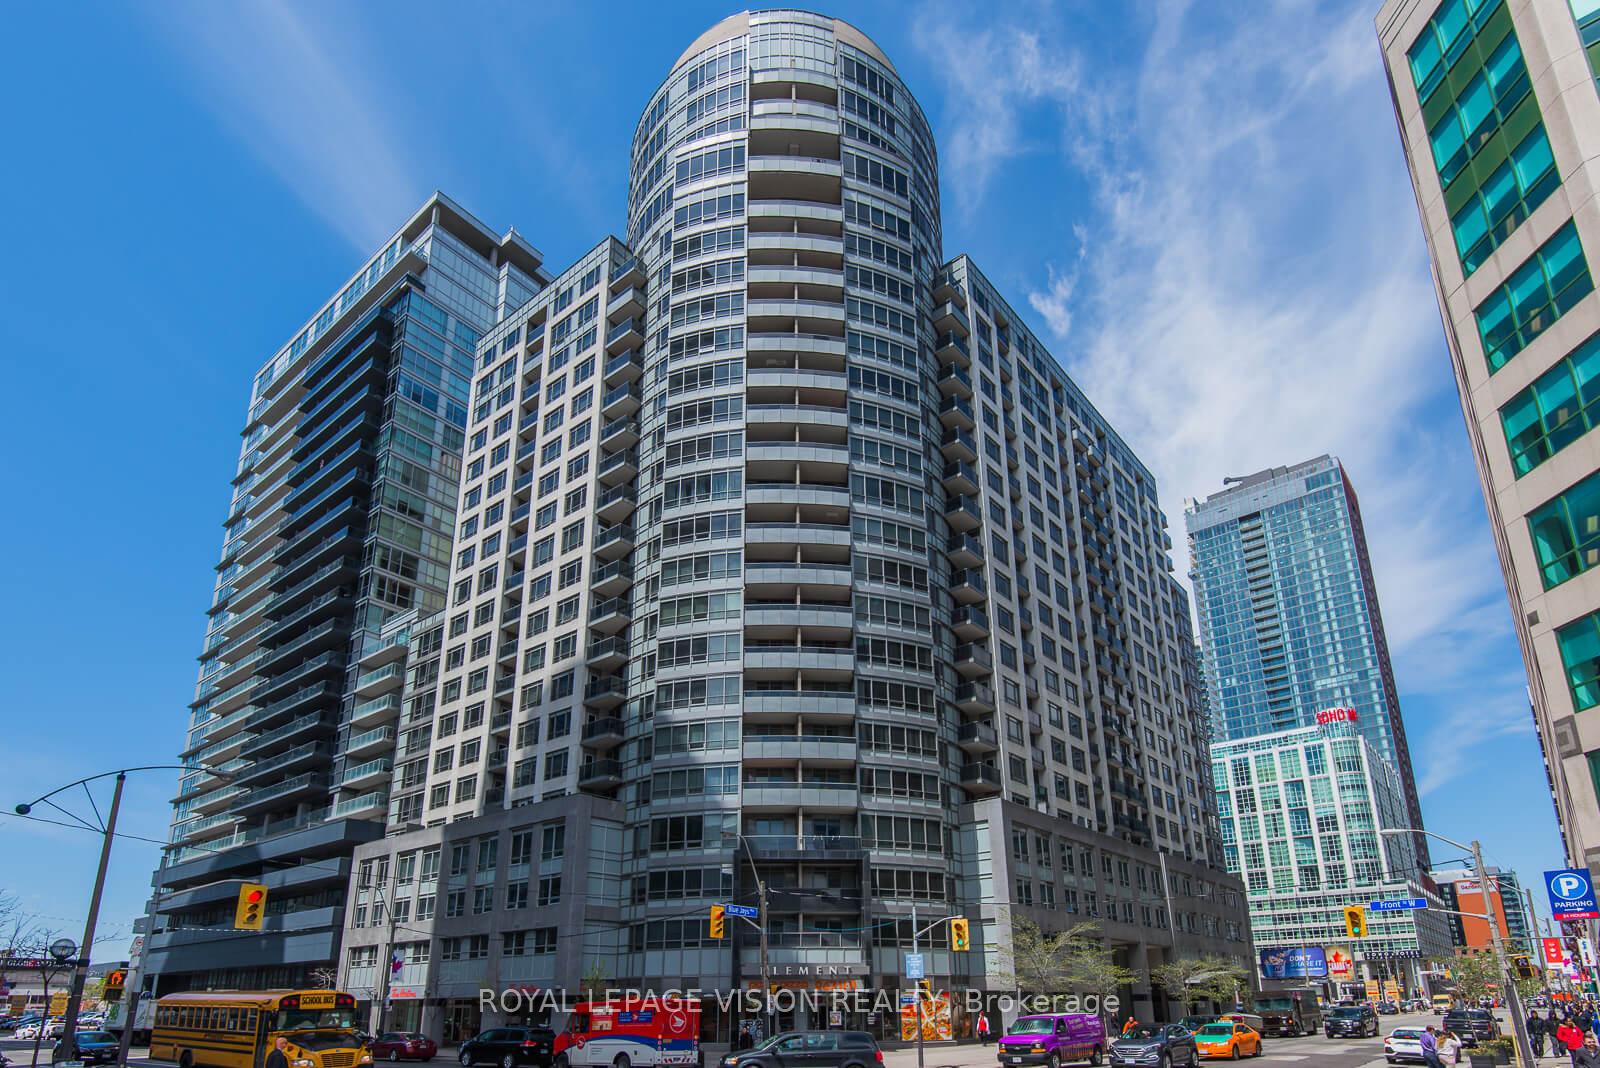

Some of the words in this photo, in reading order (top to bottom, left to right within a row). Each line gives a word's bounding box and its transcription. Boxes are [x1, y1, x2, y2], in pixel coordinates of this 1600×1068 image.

[1316, 708, 1345, 725] SOHO
[1380, 901, 1400, 909] Front
[1408, 899, 1416, 907] W
[1554, 900, 1593, 908] PARKING
[728, 905, 739, 913] Blue
[740, 908, 750, 916] Jays
[302, 995, 321, 1005] SCHOOL
[323, 995, 334, 1004] BUS
